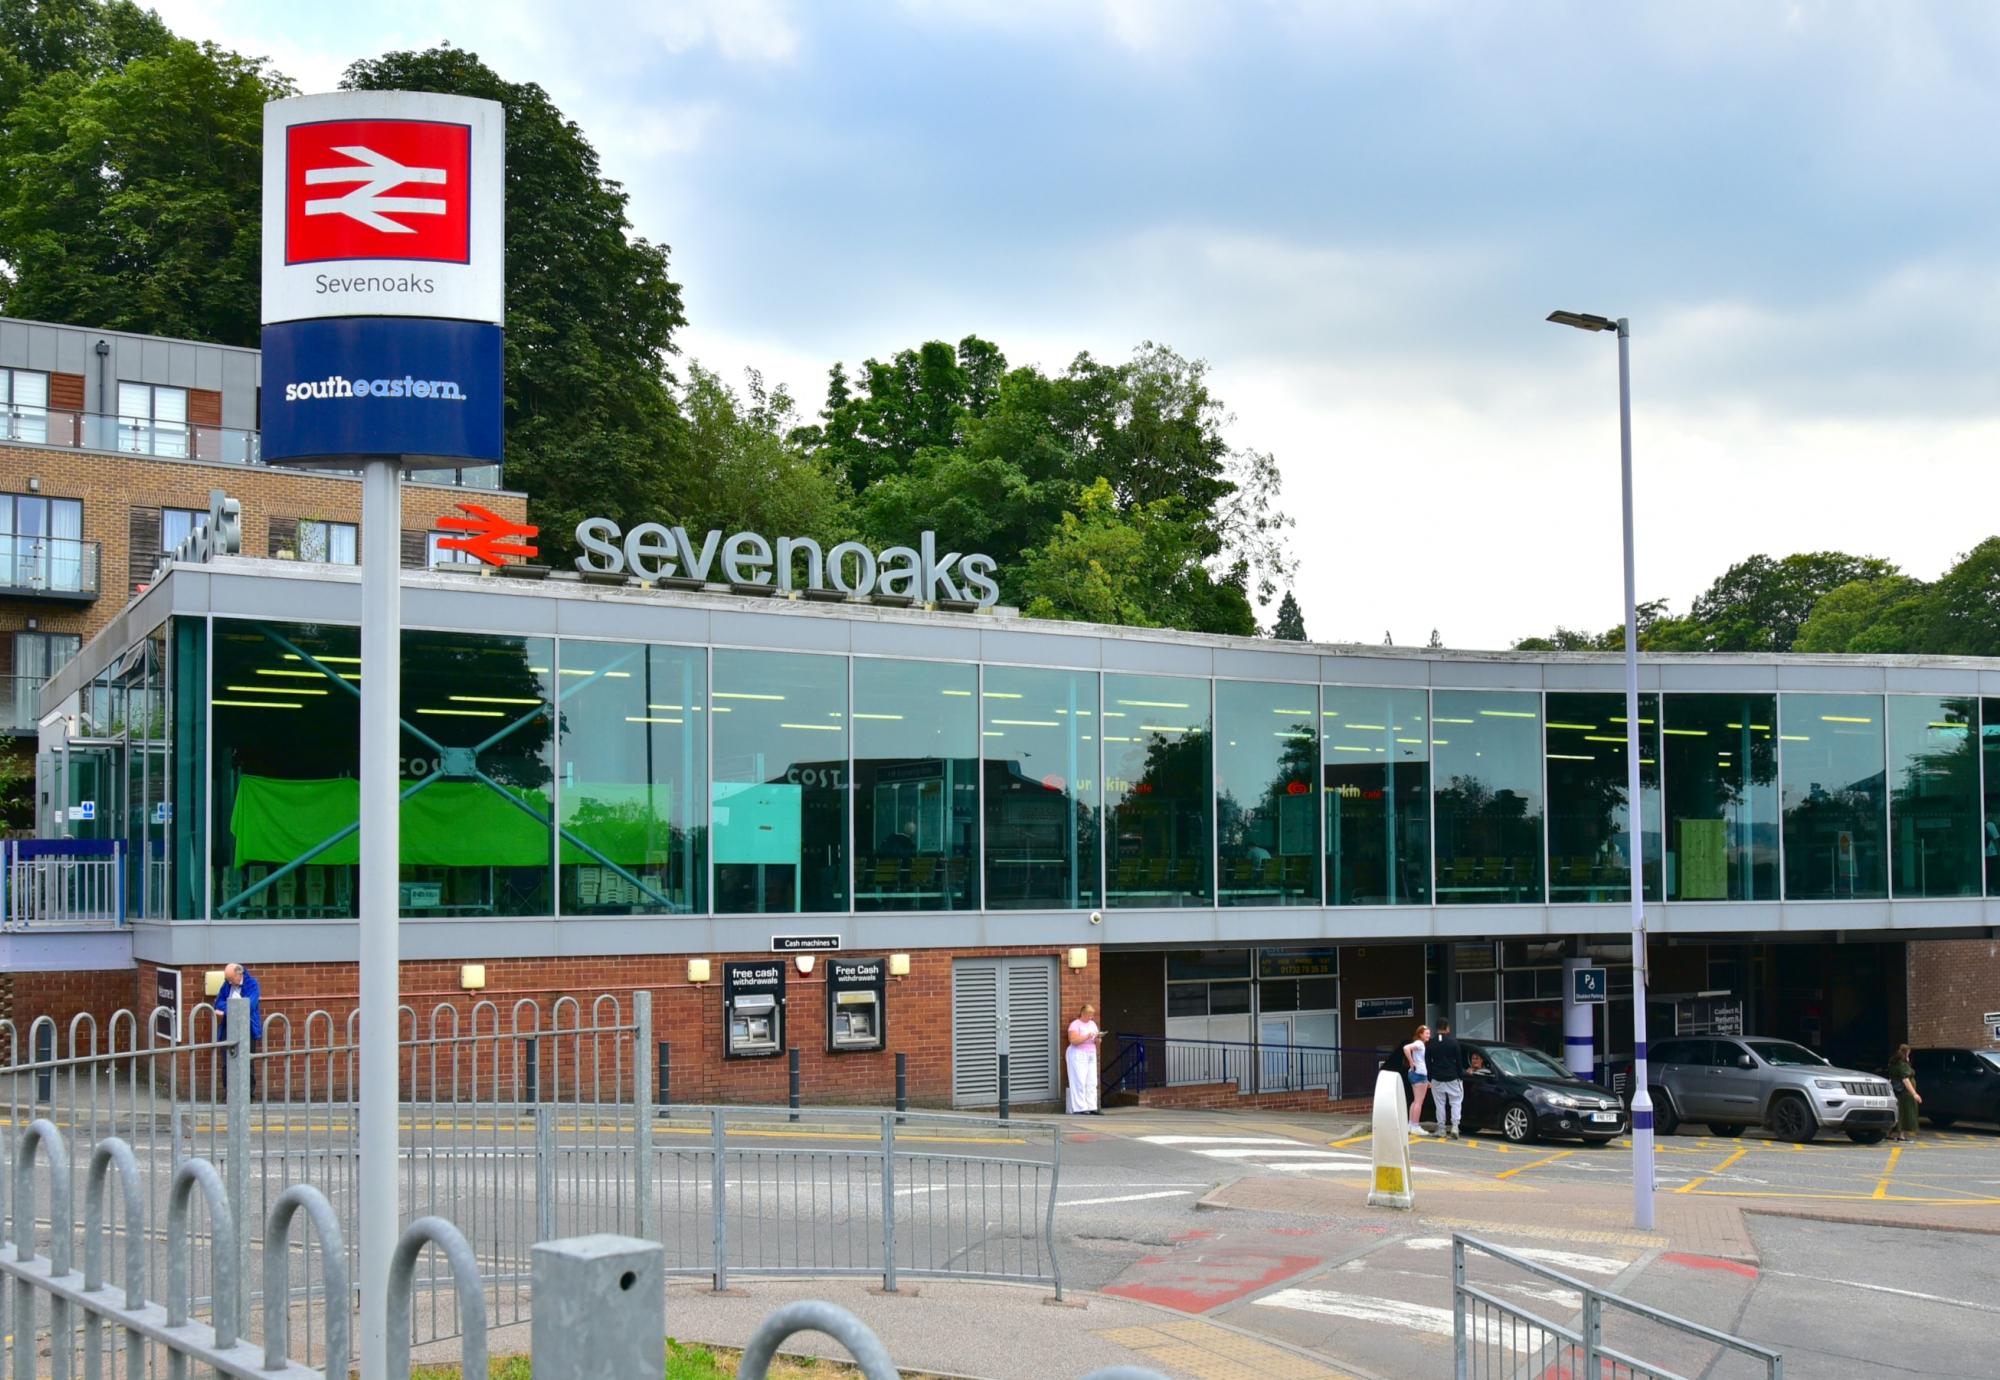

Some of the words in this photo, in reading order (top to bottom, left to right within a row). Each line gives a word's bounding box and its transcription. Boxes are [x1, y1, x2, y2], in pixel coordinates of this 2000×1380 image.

[315, 273, 435, 295] Sevenoaks
[574, 517, 1000, 608] sevenoaks
[784, 939, 800, 947] Cash
[800, 939, 831, 947] machines
[732, 968, 753, 978] free
[754, 967, 779, 977] cash
[835, 966, 856, 975] Free
[857, 965, 879, 975] Cash
[732, 977, 779, 986] withdrawals
[838, 974, 877, 982] withdrawals
